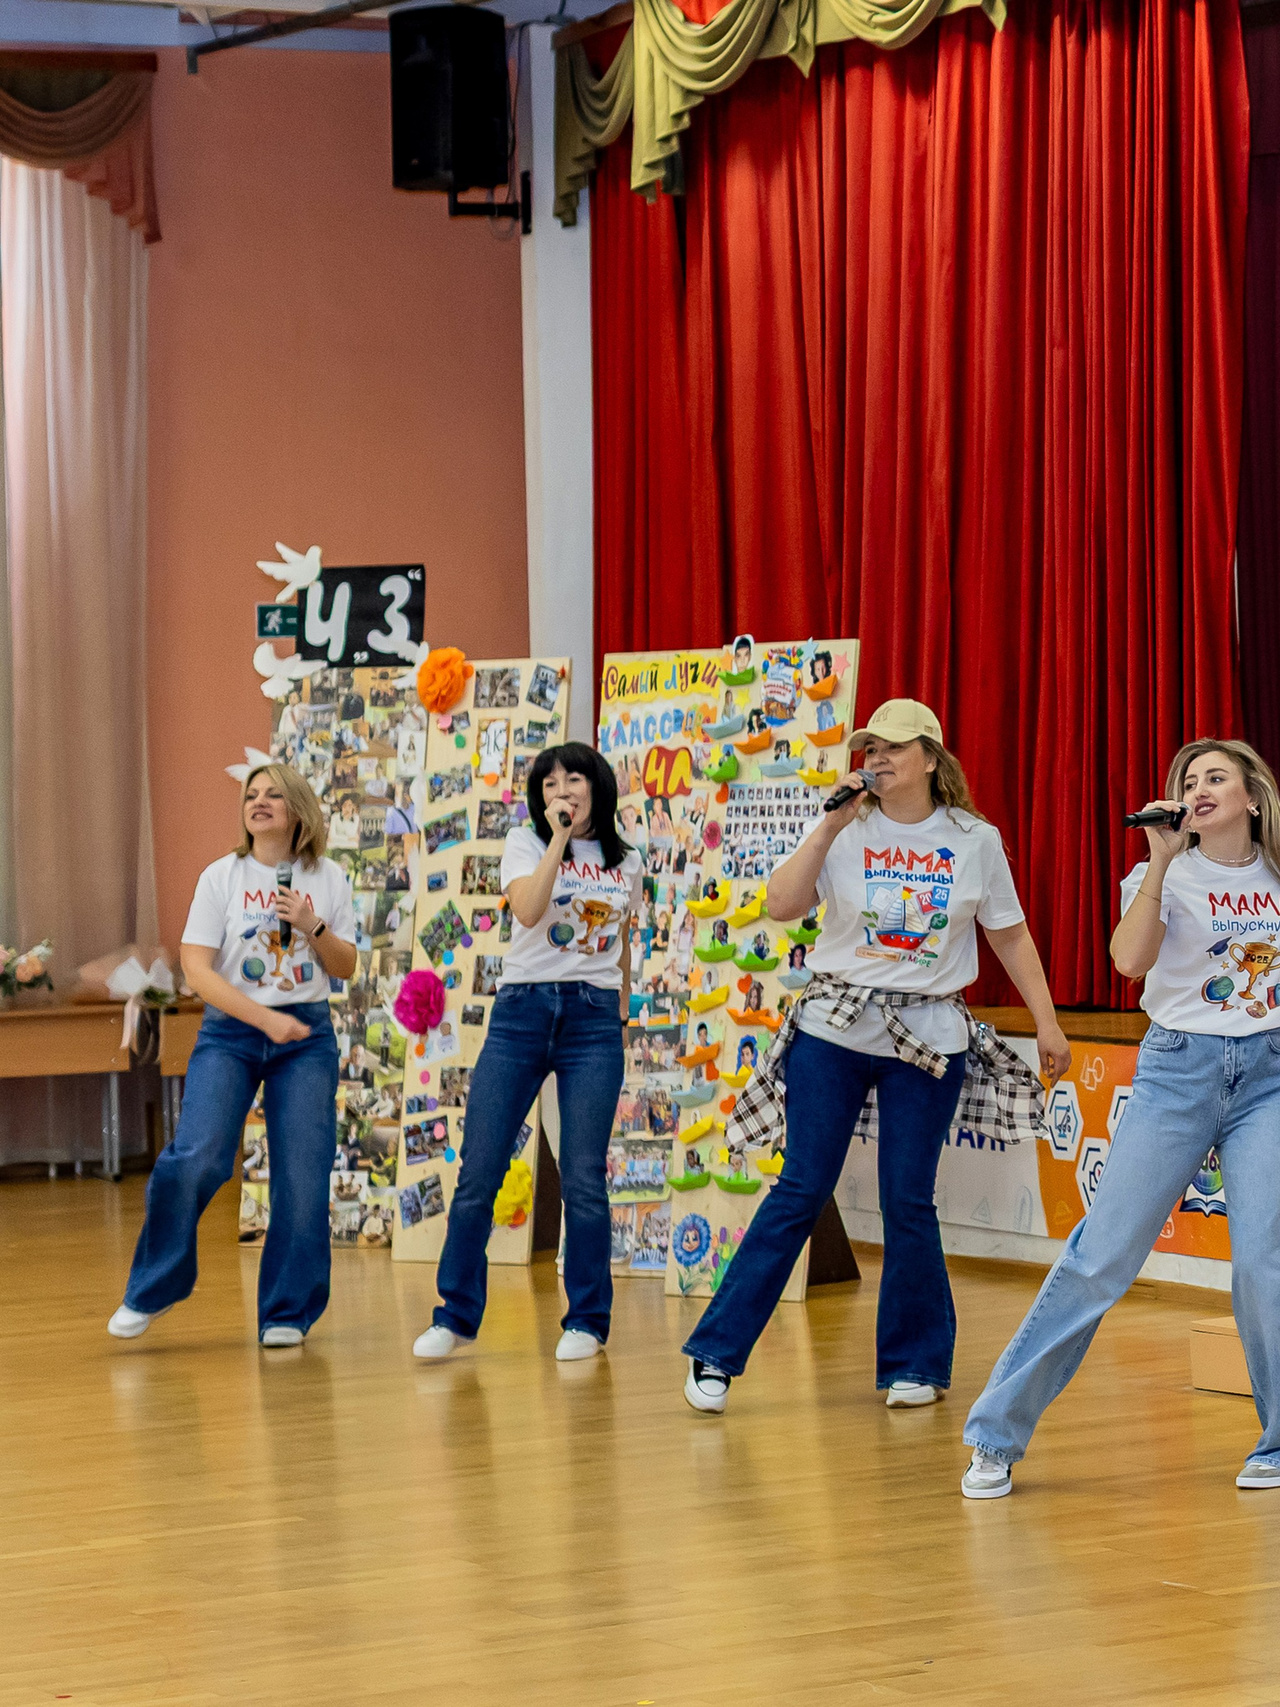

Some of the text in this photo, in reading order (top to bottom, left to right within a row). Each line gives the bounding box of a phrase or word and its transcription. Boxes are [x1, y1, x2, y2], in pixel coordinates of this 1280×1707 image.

[864, 845, 953, 874] МАМА
[864, 869, 954, 884] ВЫПУСКНИЦЫ
[244, 888, 315, 912] МАА
[934, 888, 948, 901] 25
